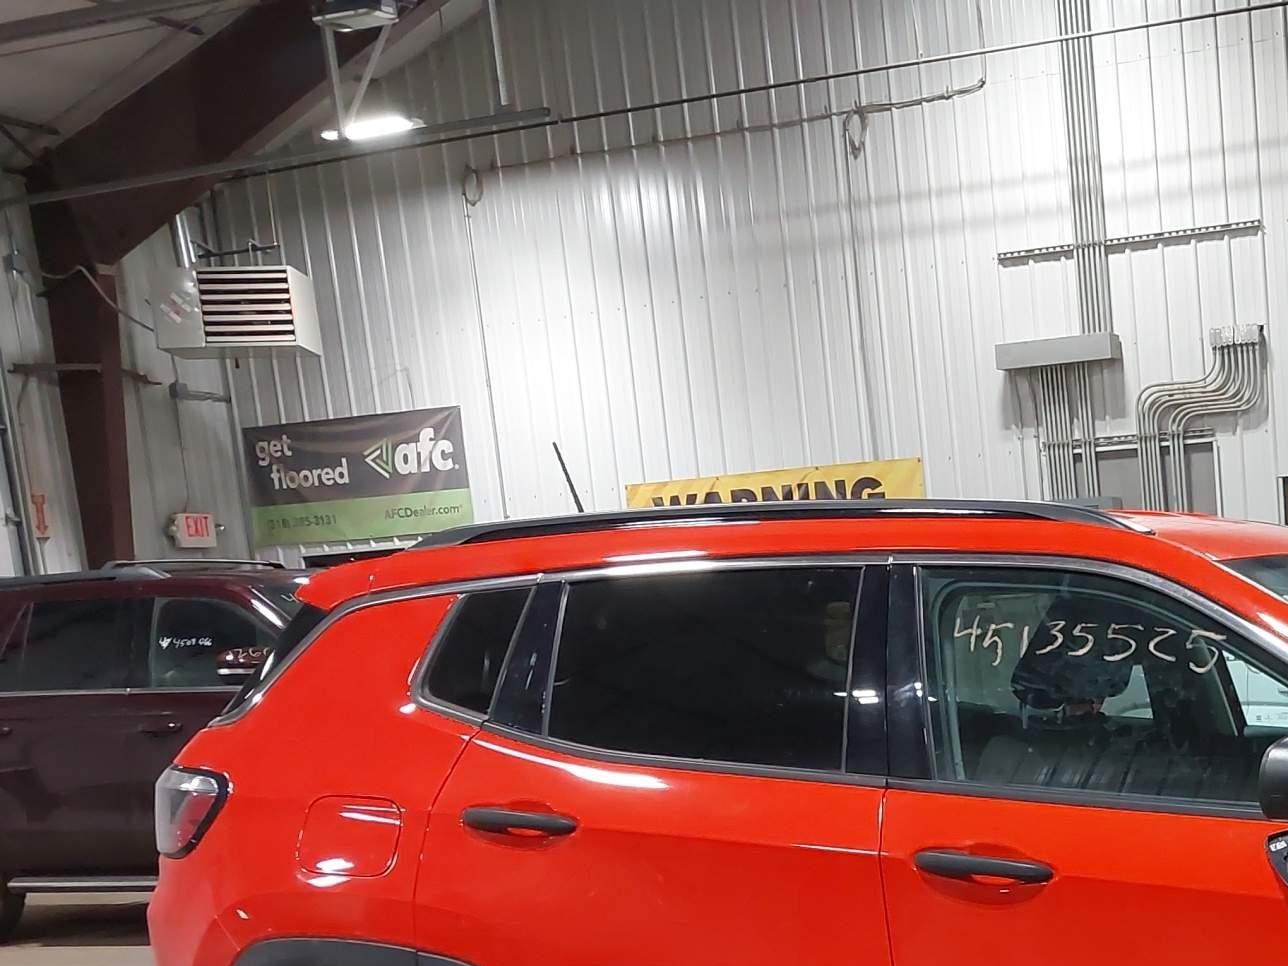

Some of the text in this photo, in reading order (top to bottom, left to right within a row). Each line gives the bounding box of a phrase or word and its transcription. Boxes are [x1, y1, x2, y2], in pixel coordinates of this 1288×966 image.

[255, 434, 293, 466] get
[270, 457, 350, 490] floored
[953, 615, 1227, 674] 45135525
